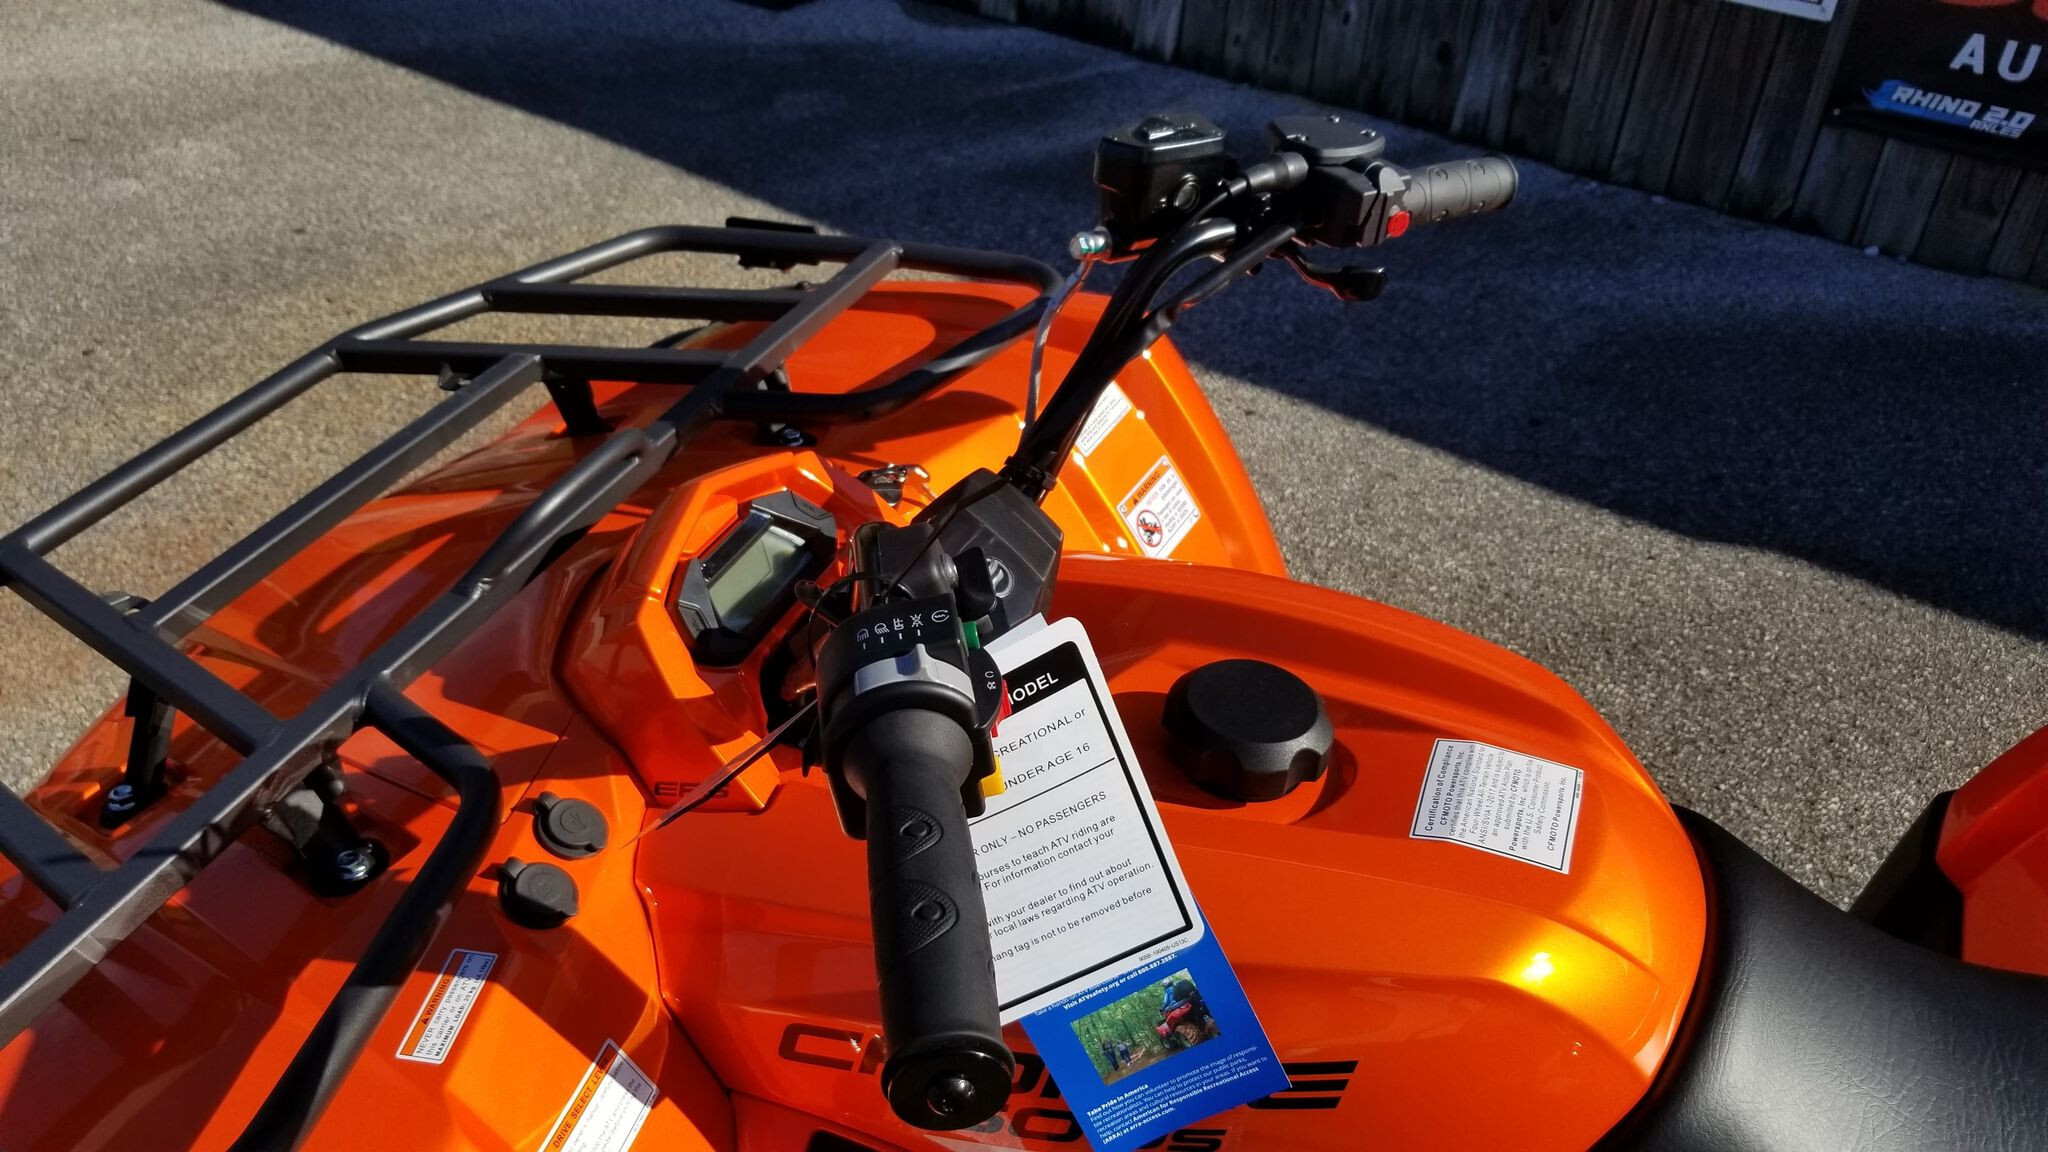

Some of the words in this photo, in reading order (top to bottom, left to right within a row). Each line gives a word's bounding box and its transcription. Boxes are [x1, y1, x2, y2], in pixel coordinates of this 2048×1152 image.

[1891, 85, 1982, 119] RHINO
[1983, 105, 2036, 128] 2.0
[1137, 473, 1160, 499] WARNING
[1008, 672, 1059, 705] ODEL
[1074, 708, 1086, 720] or
[1047, 752, 1074, 770] AGE
[1076, 742, 1091, 756] 16
[1438, 744, 1453, 779] Compliance
[1435, 778, 1444, 786] of
[1458, 775, 1467, 787] ATV
[1510, 768, 1520, 792] CFMOTO
[980, 835, 1007, 853] ONLY
[1017, 824, 1034, 837] NO
[1035, 791, 1106, 829] PASSENGERS
[1424, 786, 1442, 831] Certification
[1439, 796, 1452, 825] CFMOTO
[1460, 797, 1472, 827] American
[1011, 858, 1021, 866] to
[1022, 845, 1049, 861] teach
[1050, 834, 1068, 849] ATV
[1071, 823, 1098, 839] riding
[1099, 815, 1115, 826] are
[1547, 821, 1558, 851] CFMOTO
[984, 878, 1001, 891] For
[1001, 855, 1056, 882] information
[1057, 838, 1092, 858] contact
[1093, 828, 1113, 844] your
[993, 921, 1017, 936] local
[1017, 913, 1039, 926] laws
[1041, 892, 1085, 916] regarding
[1086, 881, 1104, 896] ATV
[1107, 863, 1153, 886] operation.
[1004, 906, 1025, 921] your
[1027, 892, 1056, 909] dealer
[1057, 888, 1068, 896] to
[1068, 877, 1087, 891] find
[1088, 870, 1103, 882] out
[1105, 858, 1131, 875] about
[1013, 941, 1030, 952] tag
[1030, 937, 1039, 945] is
[1040, 929, 1056, 941] not
[1056, 925, 1066, 933] to
[1066, 919, 1079, 929] be
[1081, 899, 1120, 923] removed
[1121, 887, 1151, 904] before
[425, 979, 450, 1016] WARNING
[1063, 1000, 1078, 1009] Visit
[1078, 981, 1119, 1003] ATVsafety.org
[1126, 971, 1138, 979] call
[416, 1027, 434, 1054] NEVER
[434, 1006, 446, 1024] carry
[426, 1042, 437, 1055] this
[436, 1016, 449, 1039] carrier
[435, 1025, 454, 1057] MAXIMUM
[1086, 1107, 1101, 1116] Take
[1101, 1099, 1117, 1109] Pride
[1123, 1084, 1148, 1098] America
[1133, 1106, 1159, 1121] American
[1168, 1088, 1202, 1104] Responsible
[1202, 1073, 1239, 1090] Recreational
[1239, 1066, 1258, 1077] Access
[553, 1122, 571, 1148] DRIVE
[571, 1088, 593, 1119] SELECT
[1102, 1130, 1123, 1144] (ARRA)
